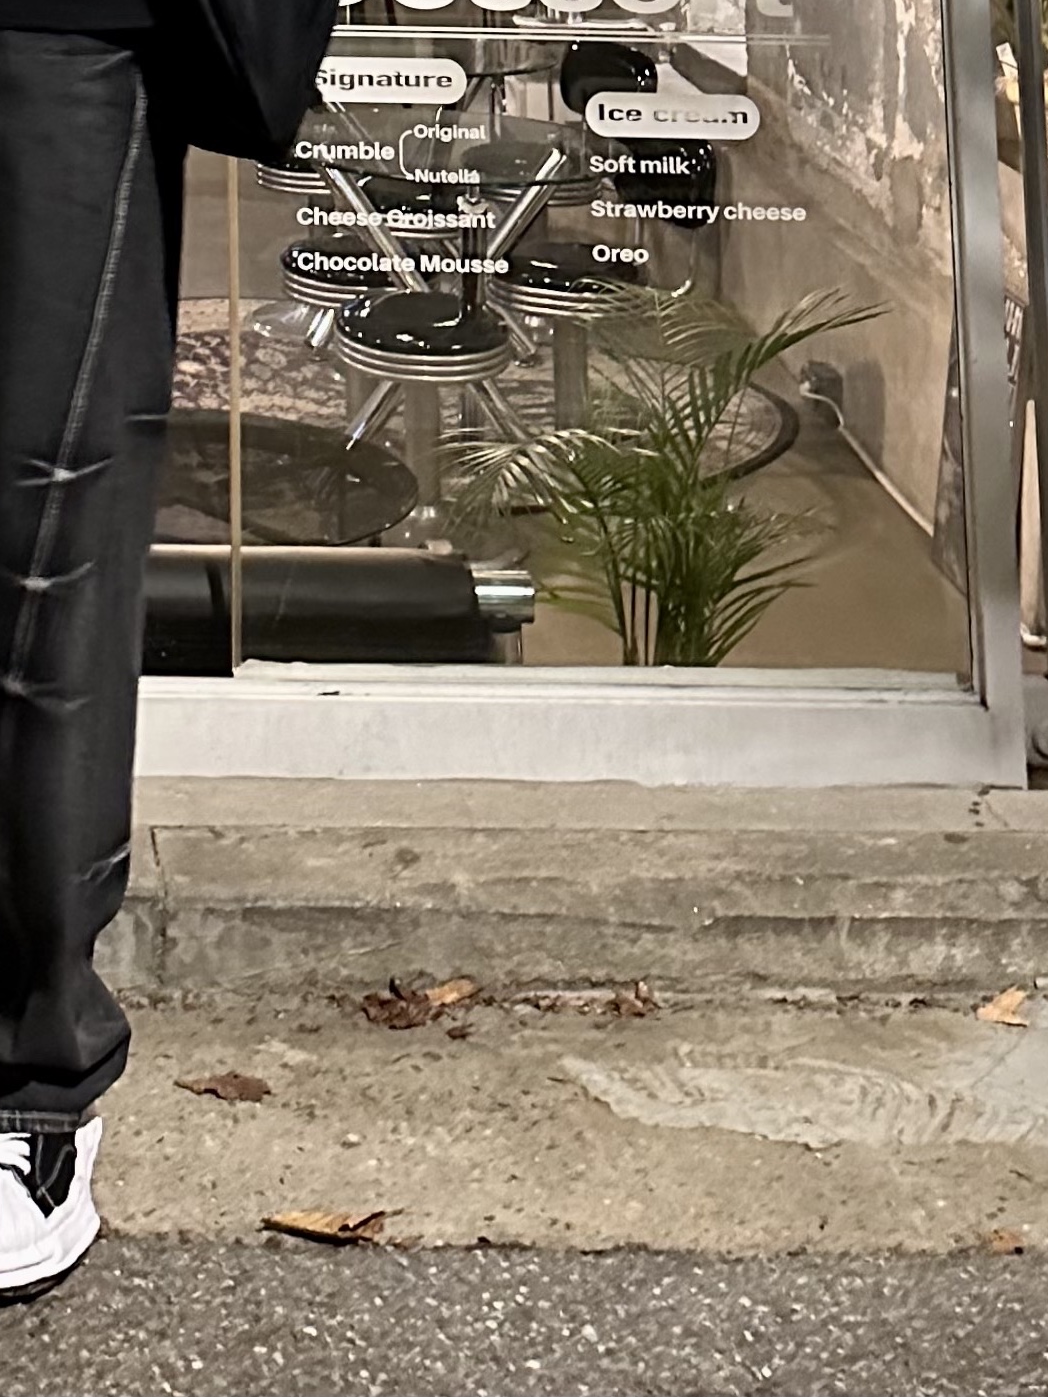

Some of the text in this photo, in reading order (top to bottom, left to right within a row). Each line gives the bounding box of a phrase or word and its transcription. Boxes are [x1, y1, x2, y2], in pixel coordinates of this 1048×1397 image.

[317, 69, 453, 90] Signature
[598, 104, 642, 121] Ice
[413, 124, 486, 143] Original
[295, 141, 395, 161] Crumble
[589, 155, 690, 174] Soft milk
[414, 168, 481, 184] Nutella
[296, 207, 496, 229] Cheese Croissant
[590, 200, 807, 223] Strawberry cheese
[297, 252, 509, 274] Chocolate Mousse
[592, 244, 649, 263] Oreo
